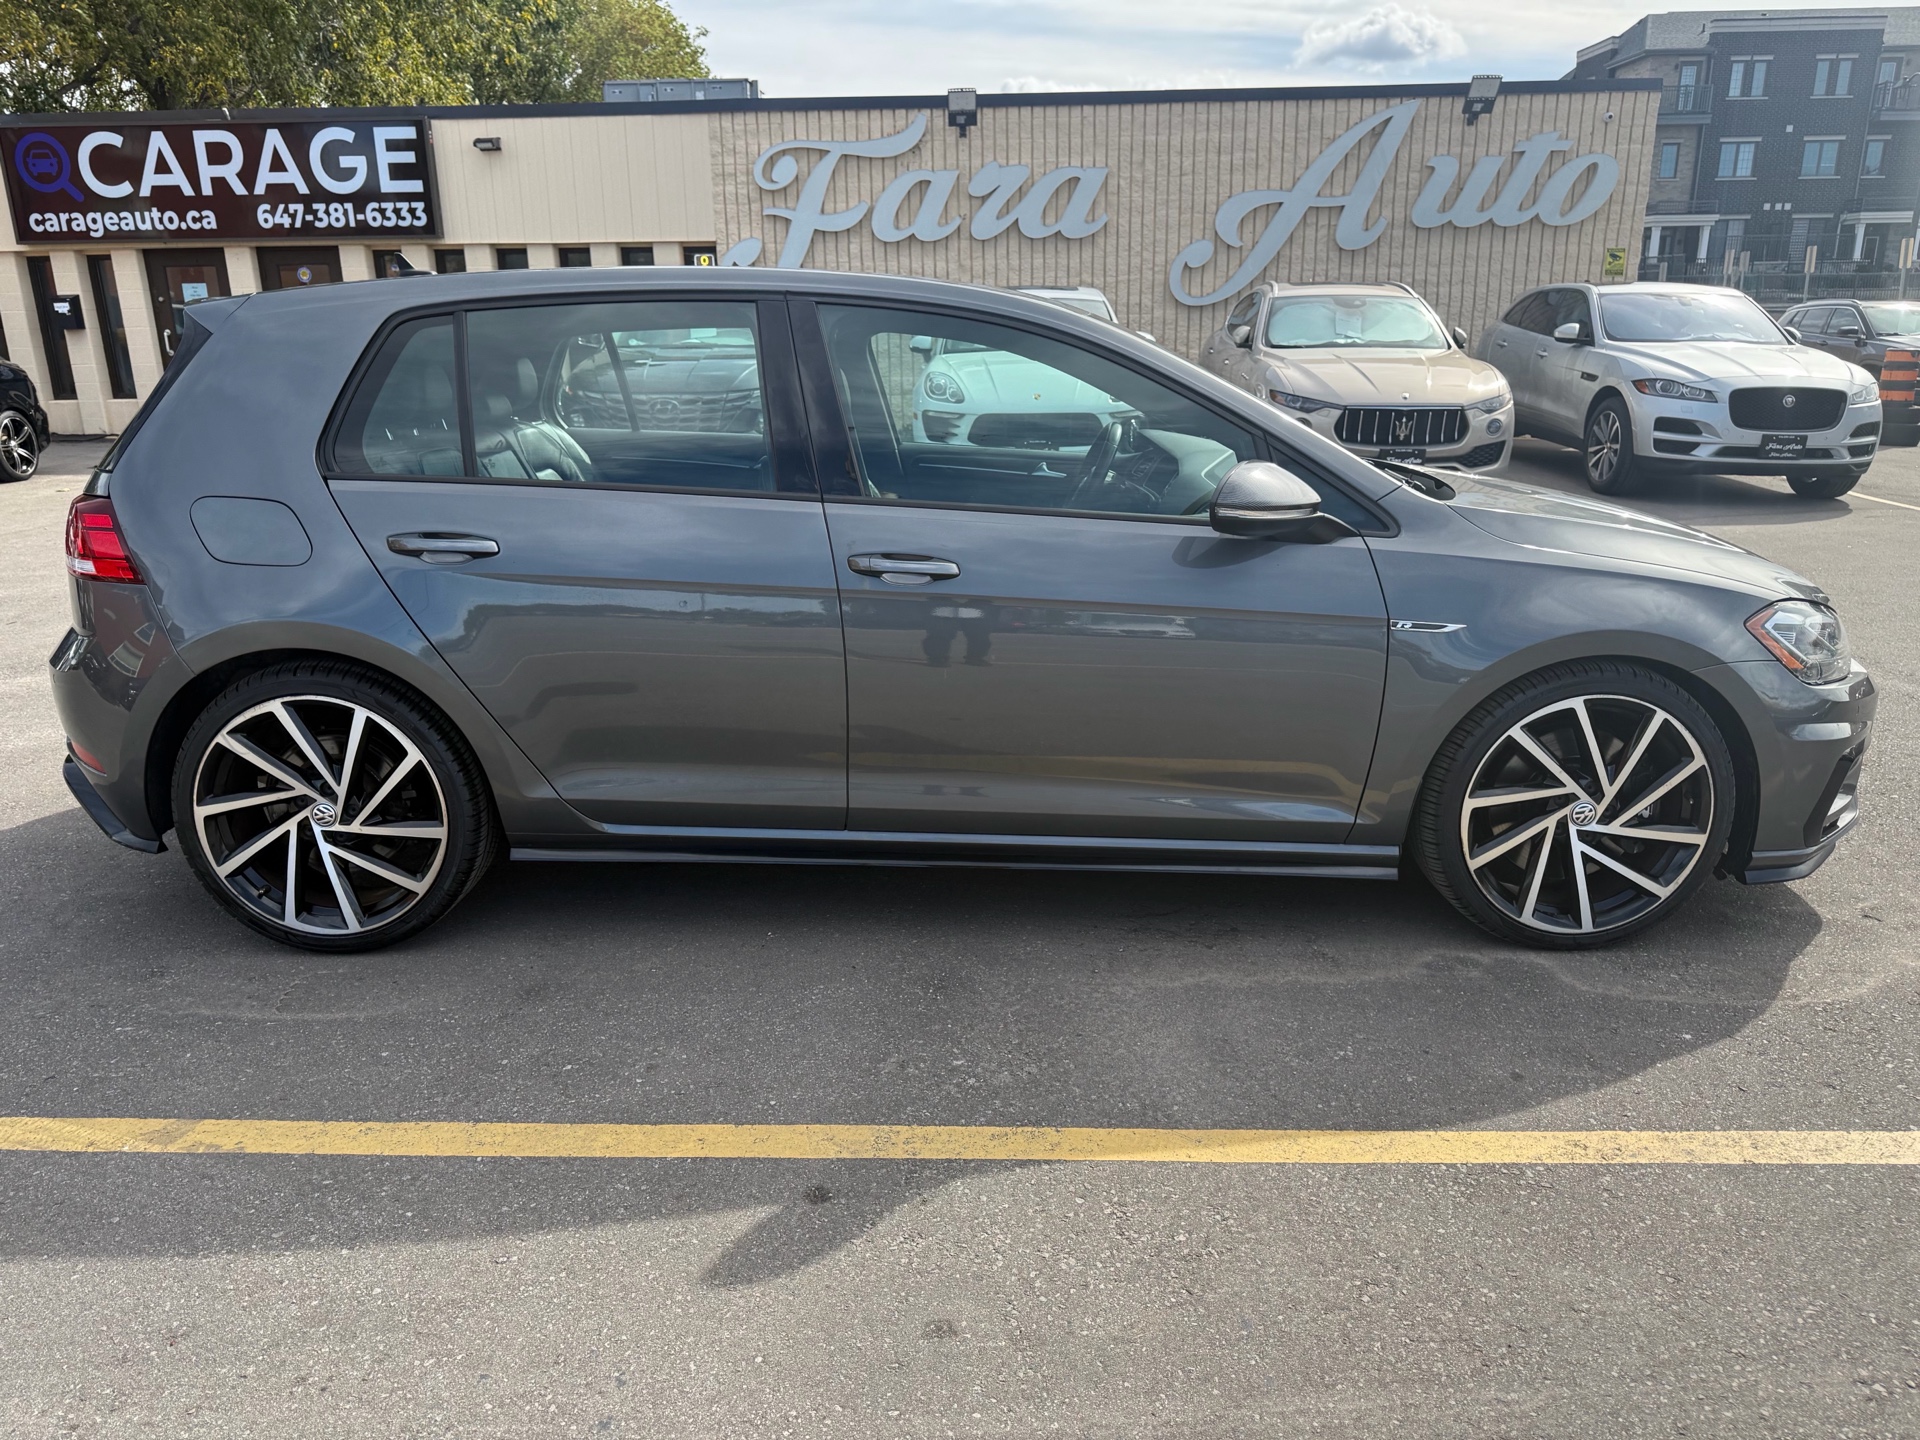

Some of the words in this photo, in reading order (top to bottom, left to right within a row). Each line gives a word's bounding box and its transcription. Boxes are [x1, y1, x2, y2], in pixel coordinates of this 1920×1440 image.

[77, 126, 425, 199] CARAGE
[28, 206, 218, 237] carageauto.ca
[256, 202, 428, 229] 647-381-6333
[721, 113, 1110, 268] Fara
[1169, 100, 1620, 306] Auto
